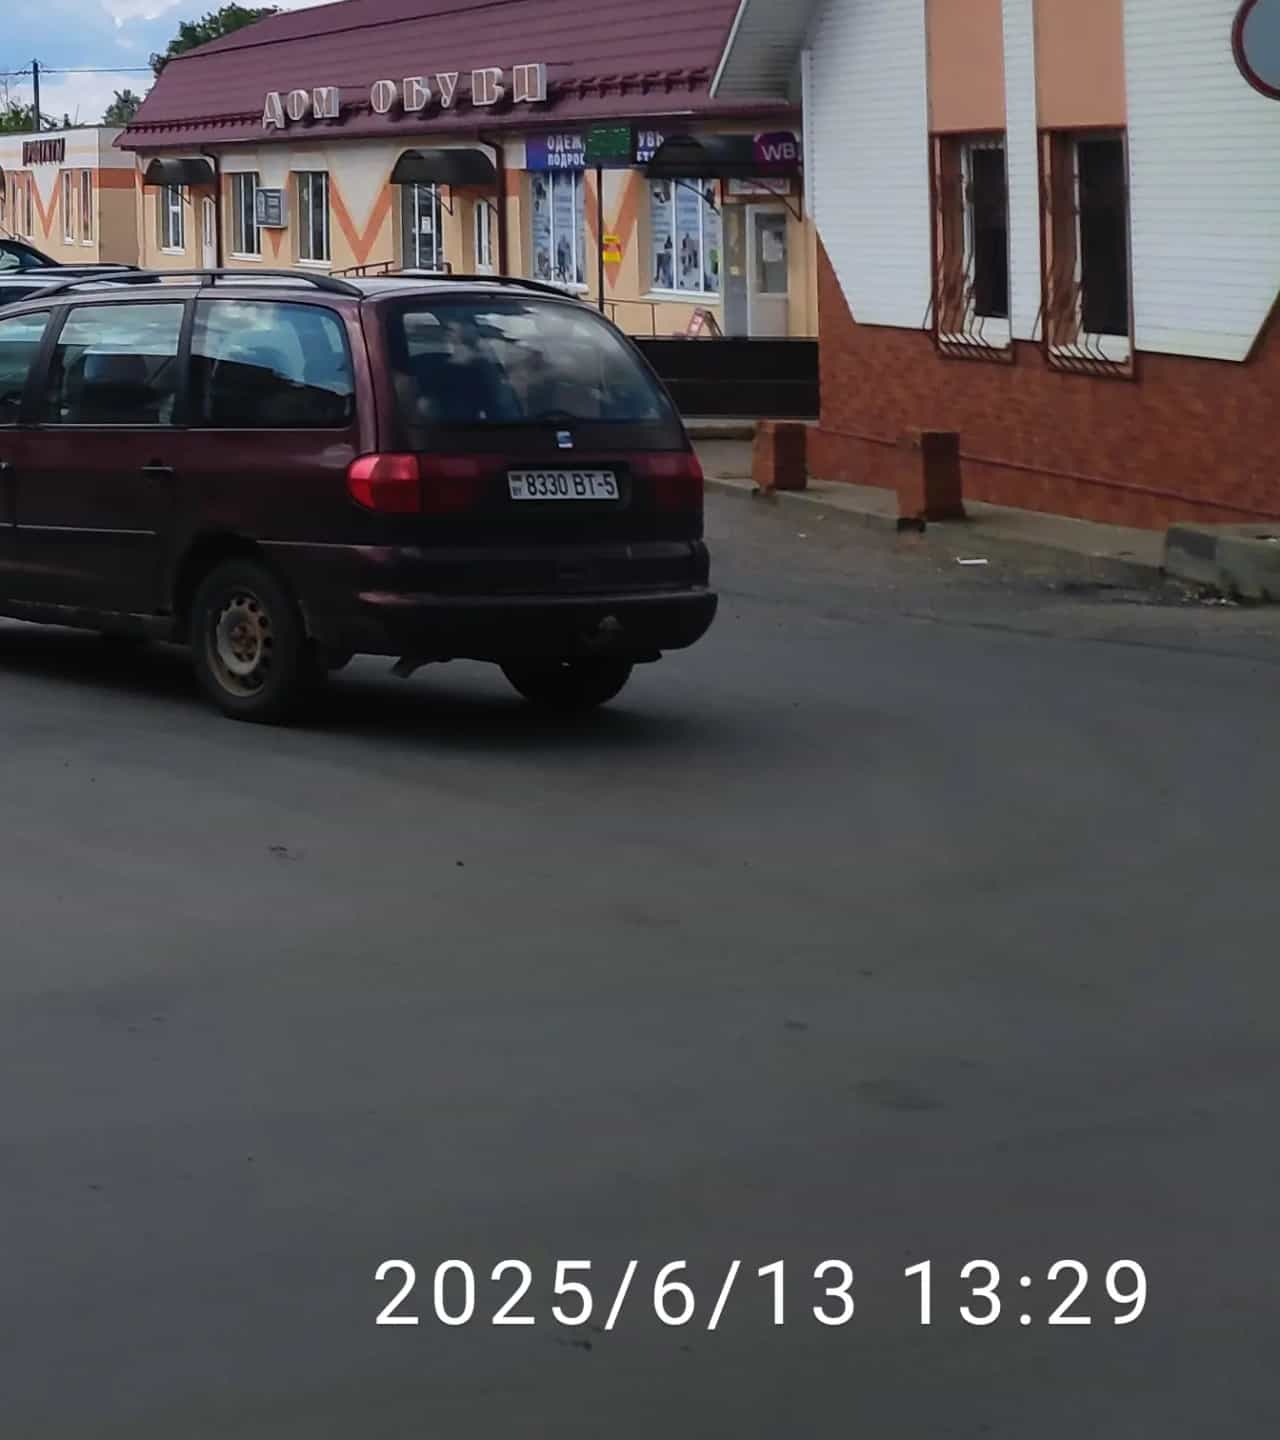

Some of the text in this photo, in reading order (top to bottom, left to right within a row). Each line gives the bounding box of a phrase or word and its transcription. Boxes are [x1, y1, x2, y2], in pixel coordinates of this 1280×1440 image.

[262, 63, 547, 129] ДОМ ОБУВИ
[546, 134, 587, 153] ОДЕЖ
[760, 142, 796, 161] WB
[547, 152, 586, 168] ПОДРОС
[526, 473, 569, 497] 8330
[572, 473, 616, 497] BT-5
